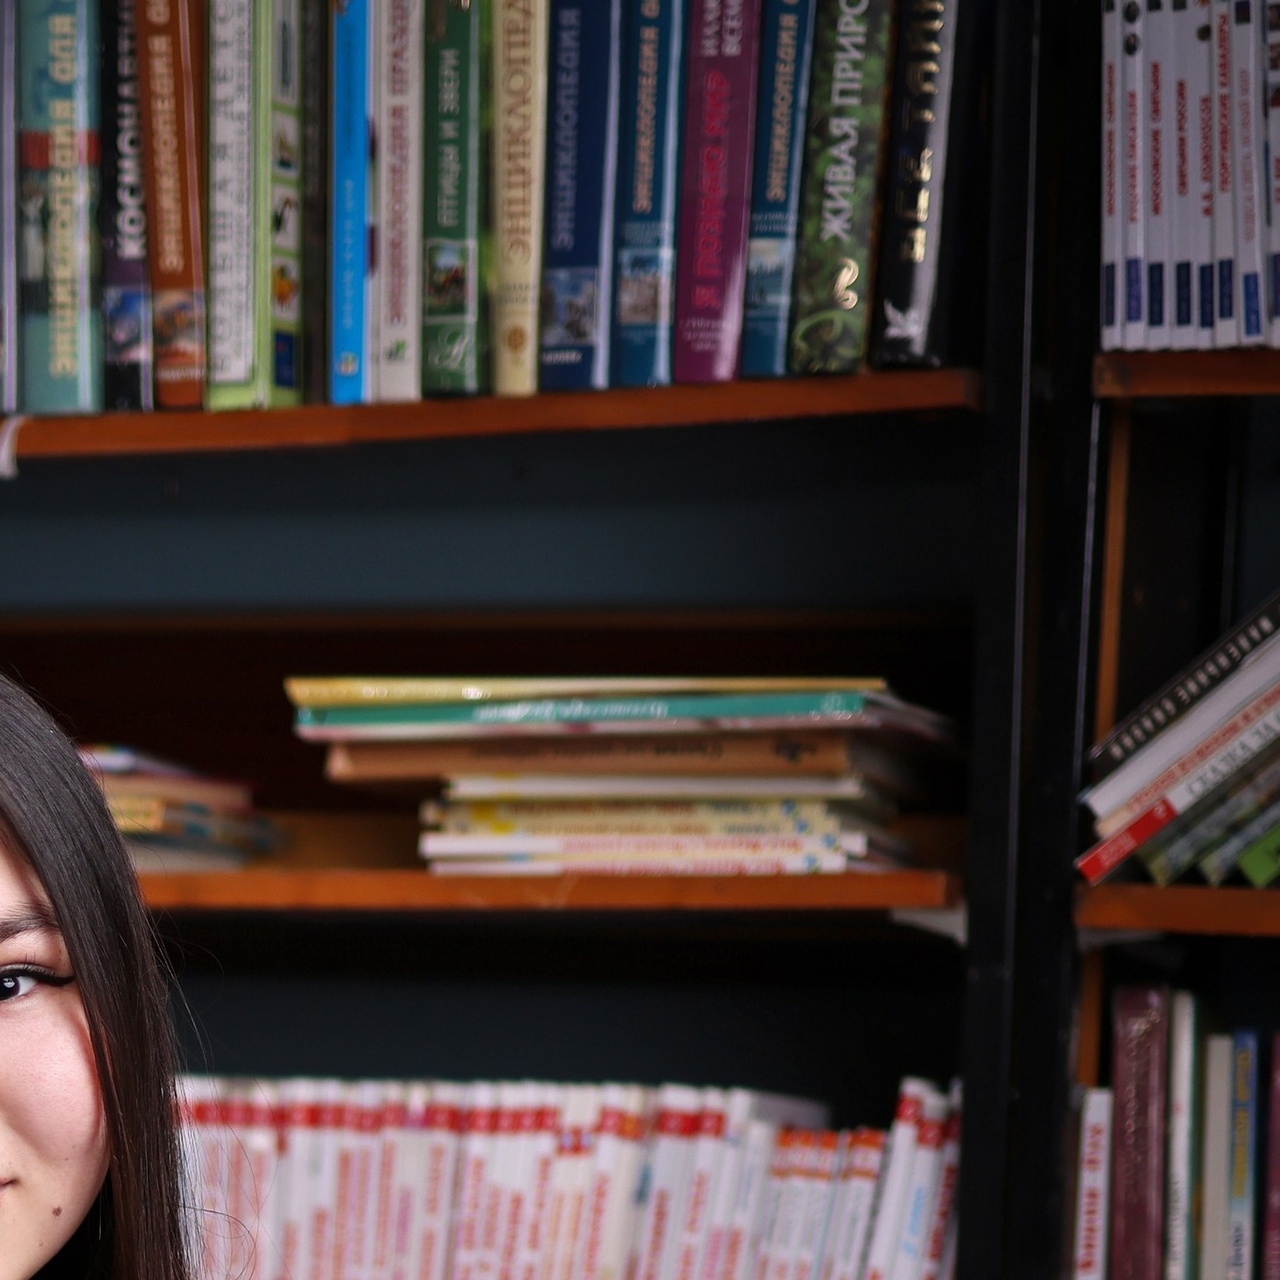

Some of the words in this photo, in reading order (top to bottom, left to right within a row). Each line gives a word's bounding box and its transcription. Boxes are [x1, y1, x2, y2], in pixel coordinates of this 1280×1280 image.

[703, 68, 730, 136] МИР
[693, 144, 727, 278] ПОЗНАЮ
[818, 114, 861, 242] ЖИВАЯ
